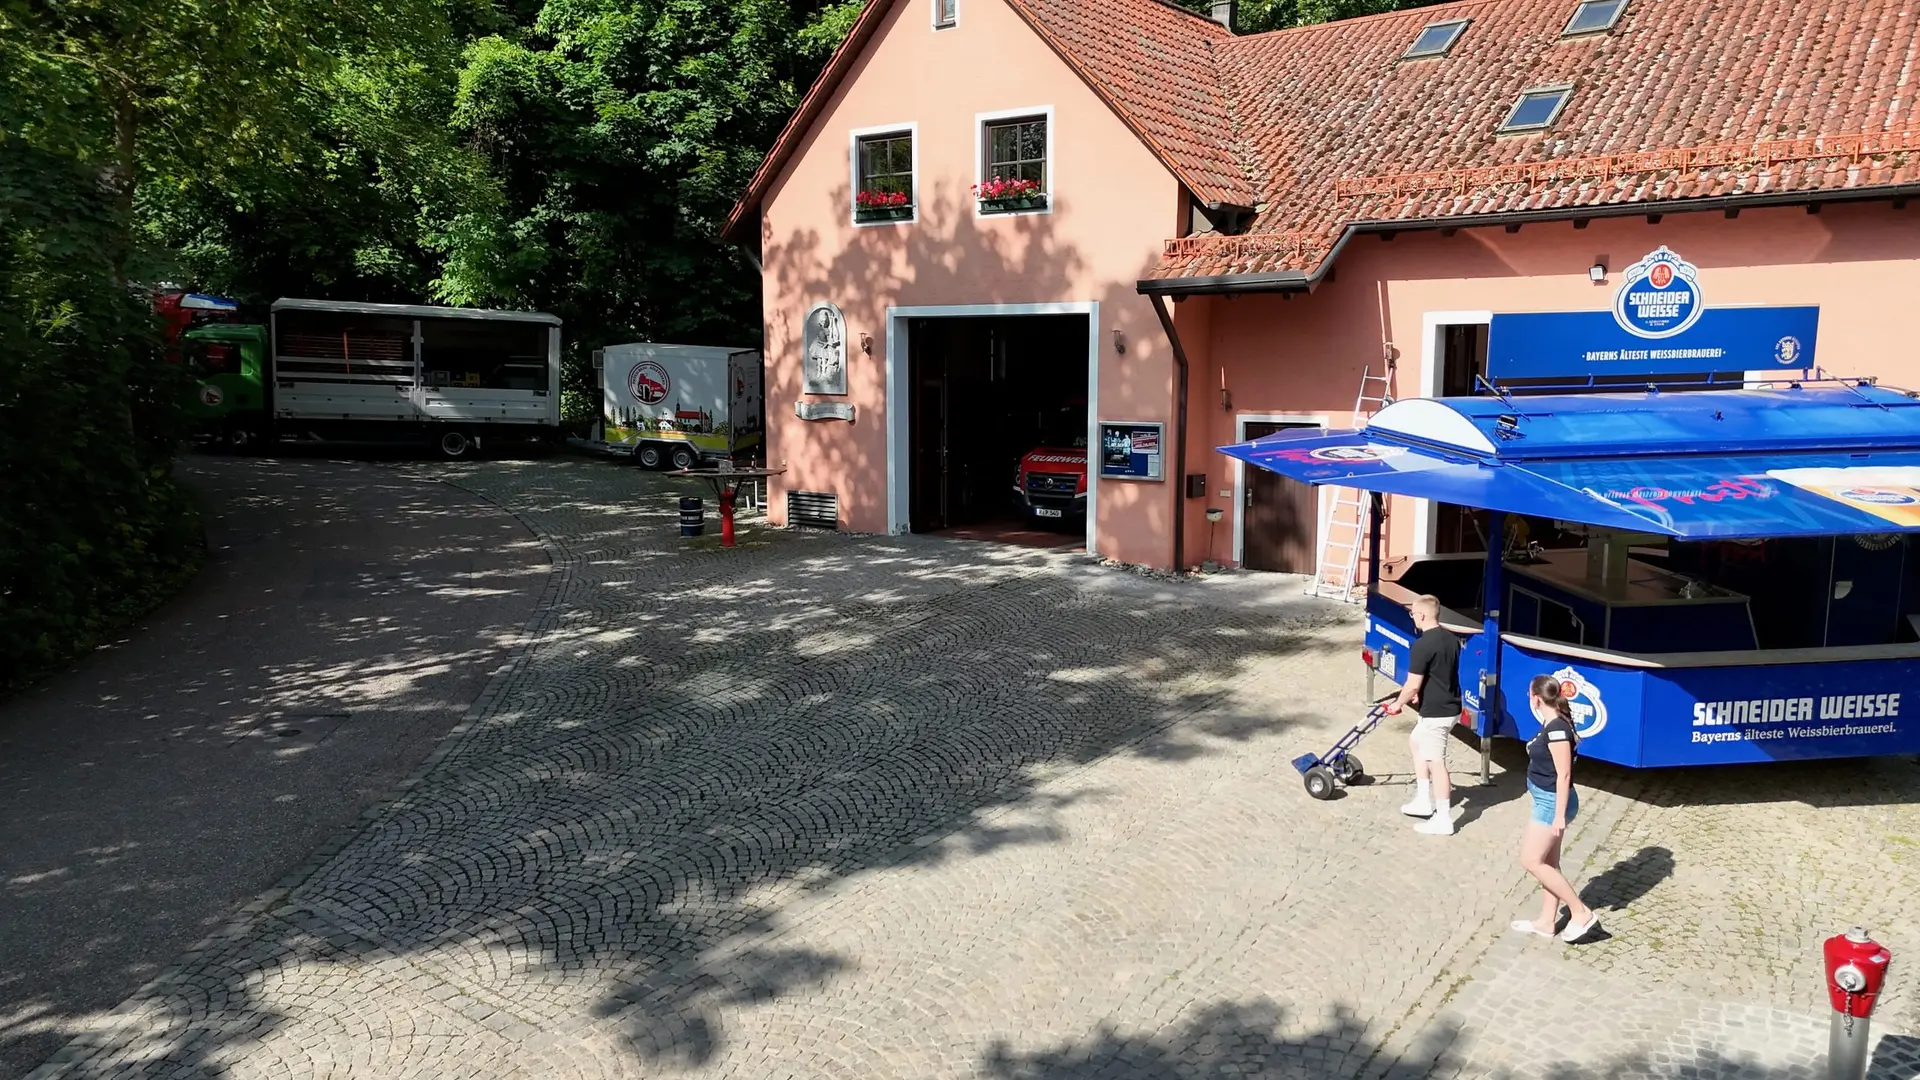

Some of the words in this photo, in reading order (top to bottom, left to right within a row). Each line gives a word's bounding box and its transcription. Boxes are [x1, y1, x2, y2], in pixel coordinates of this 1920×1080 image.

[1629, 291, 1690, 305] SCHNEIDER
[1637, 305, 1679, 318] WEISSE
[1586, 351, 1618, 362] BAYERNS
[1619, 349, 1648, 361] ÄLTESTE
[1650, 348, 1722, 360] WEISSBIERBRAUEREI
[1692, 698, 1813, 726] SCHNEIDER
[1819, 693, 1901, 720] WEISSE
[1691, 731, 1742, 745] Bayerns
[1744, 728, 1785, 741] älteste
[1787, 721, 1897, 739] Weissbierbrauerei.
